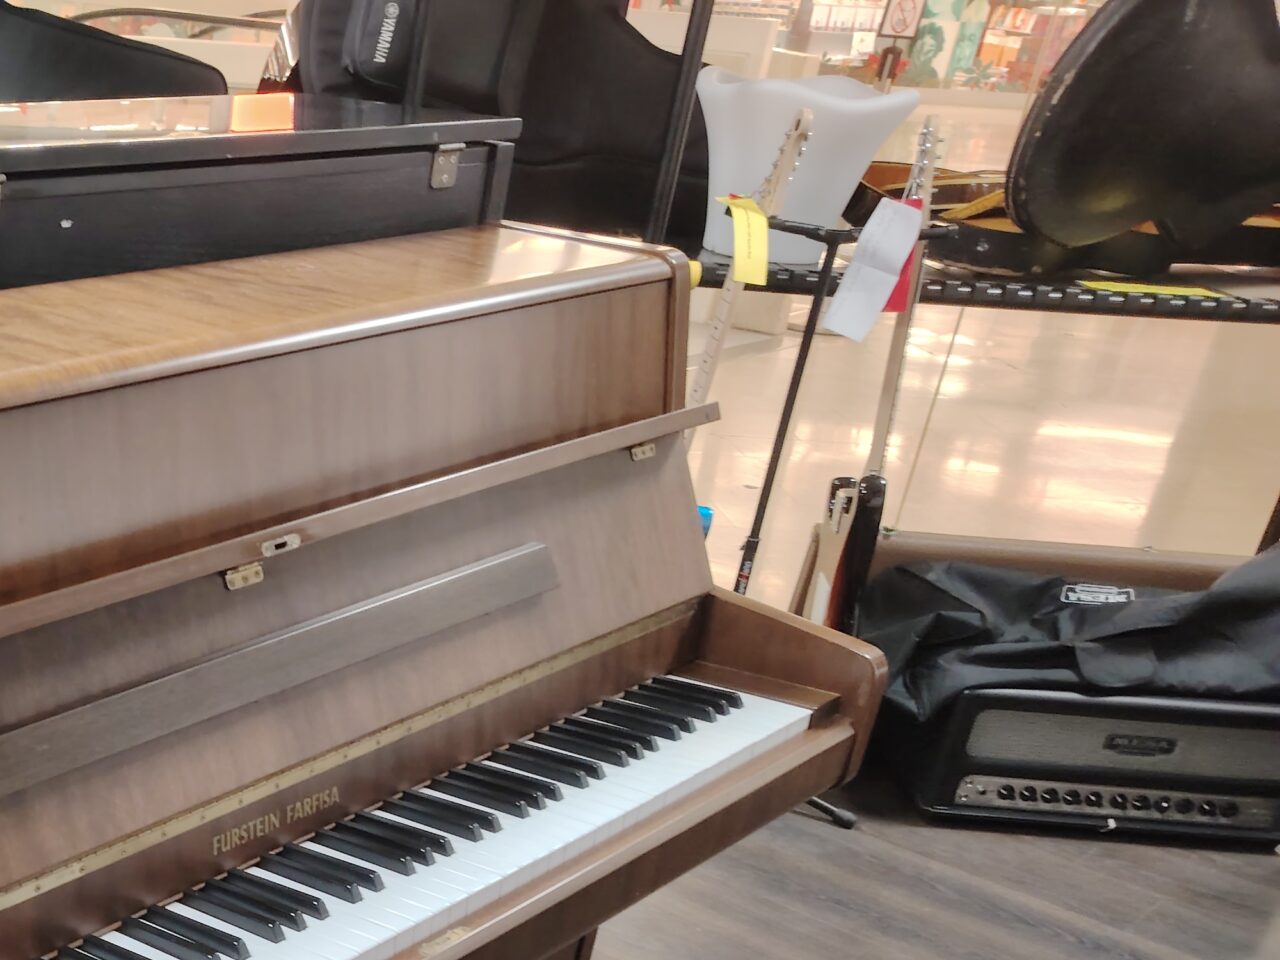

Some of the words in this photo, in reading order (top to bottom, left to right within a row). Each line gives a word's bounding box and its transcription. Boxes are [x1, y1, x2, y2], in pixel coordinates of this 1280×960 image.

[373, 18, 397, 63] YAMAHA
[212, 810, 281, 856] FURSTEIN
[286, 785, 341, 824] FARFISA
